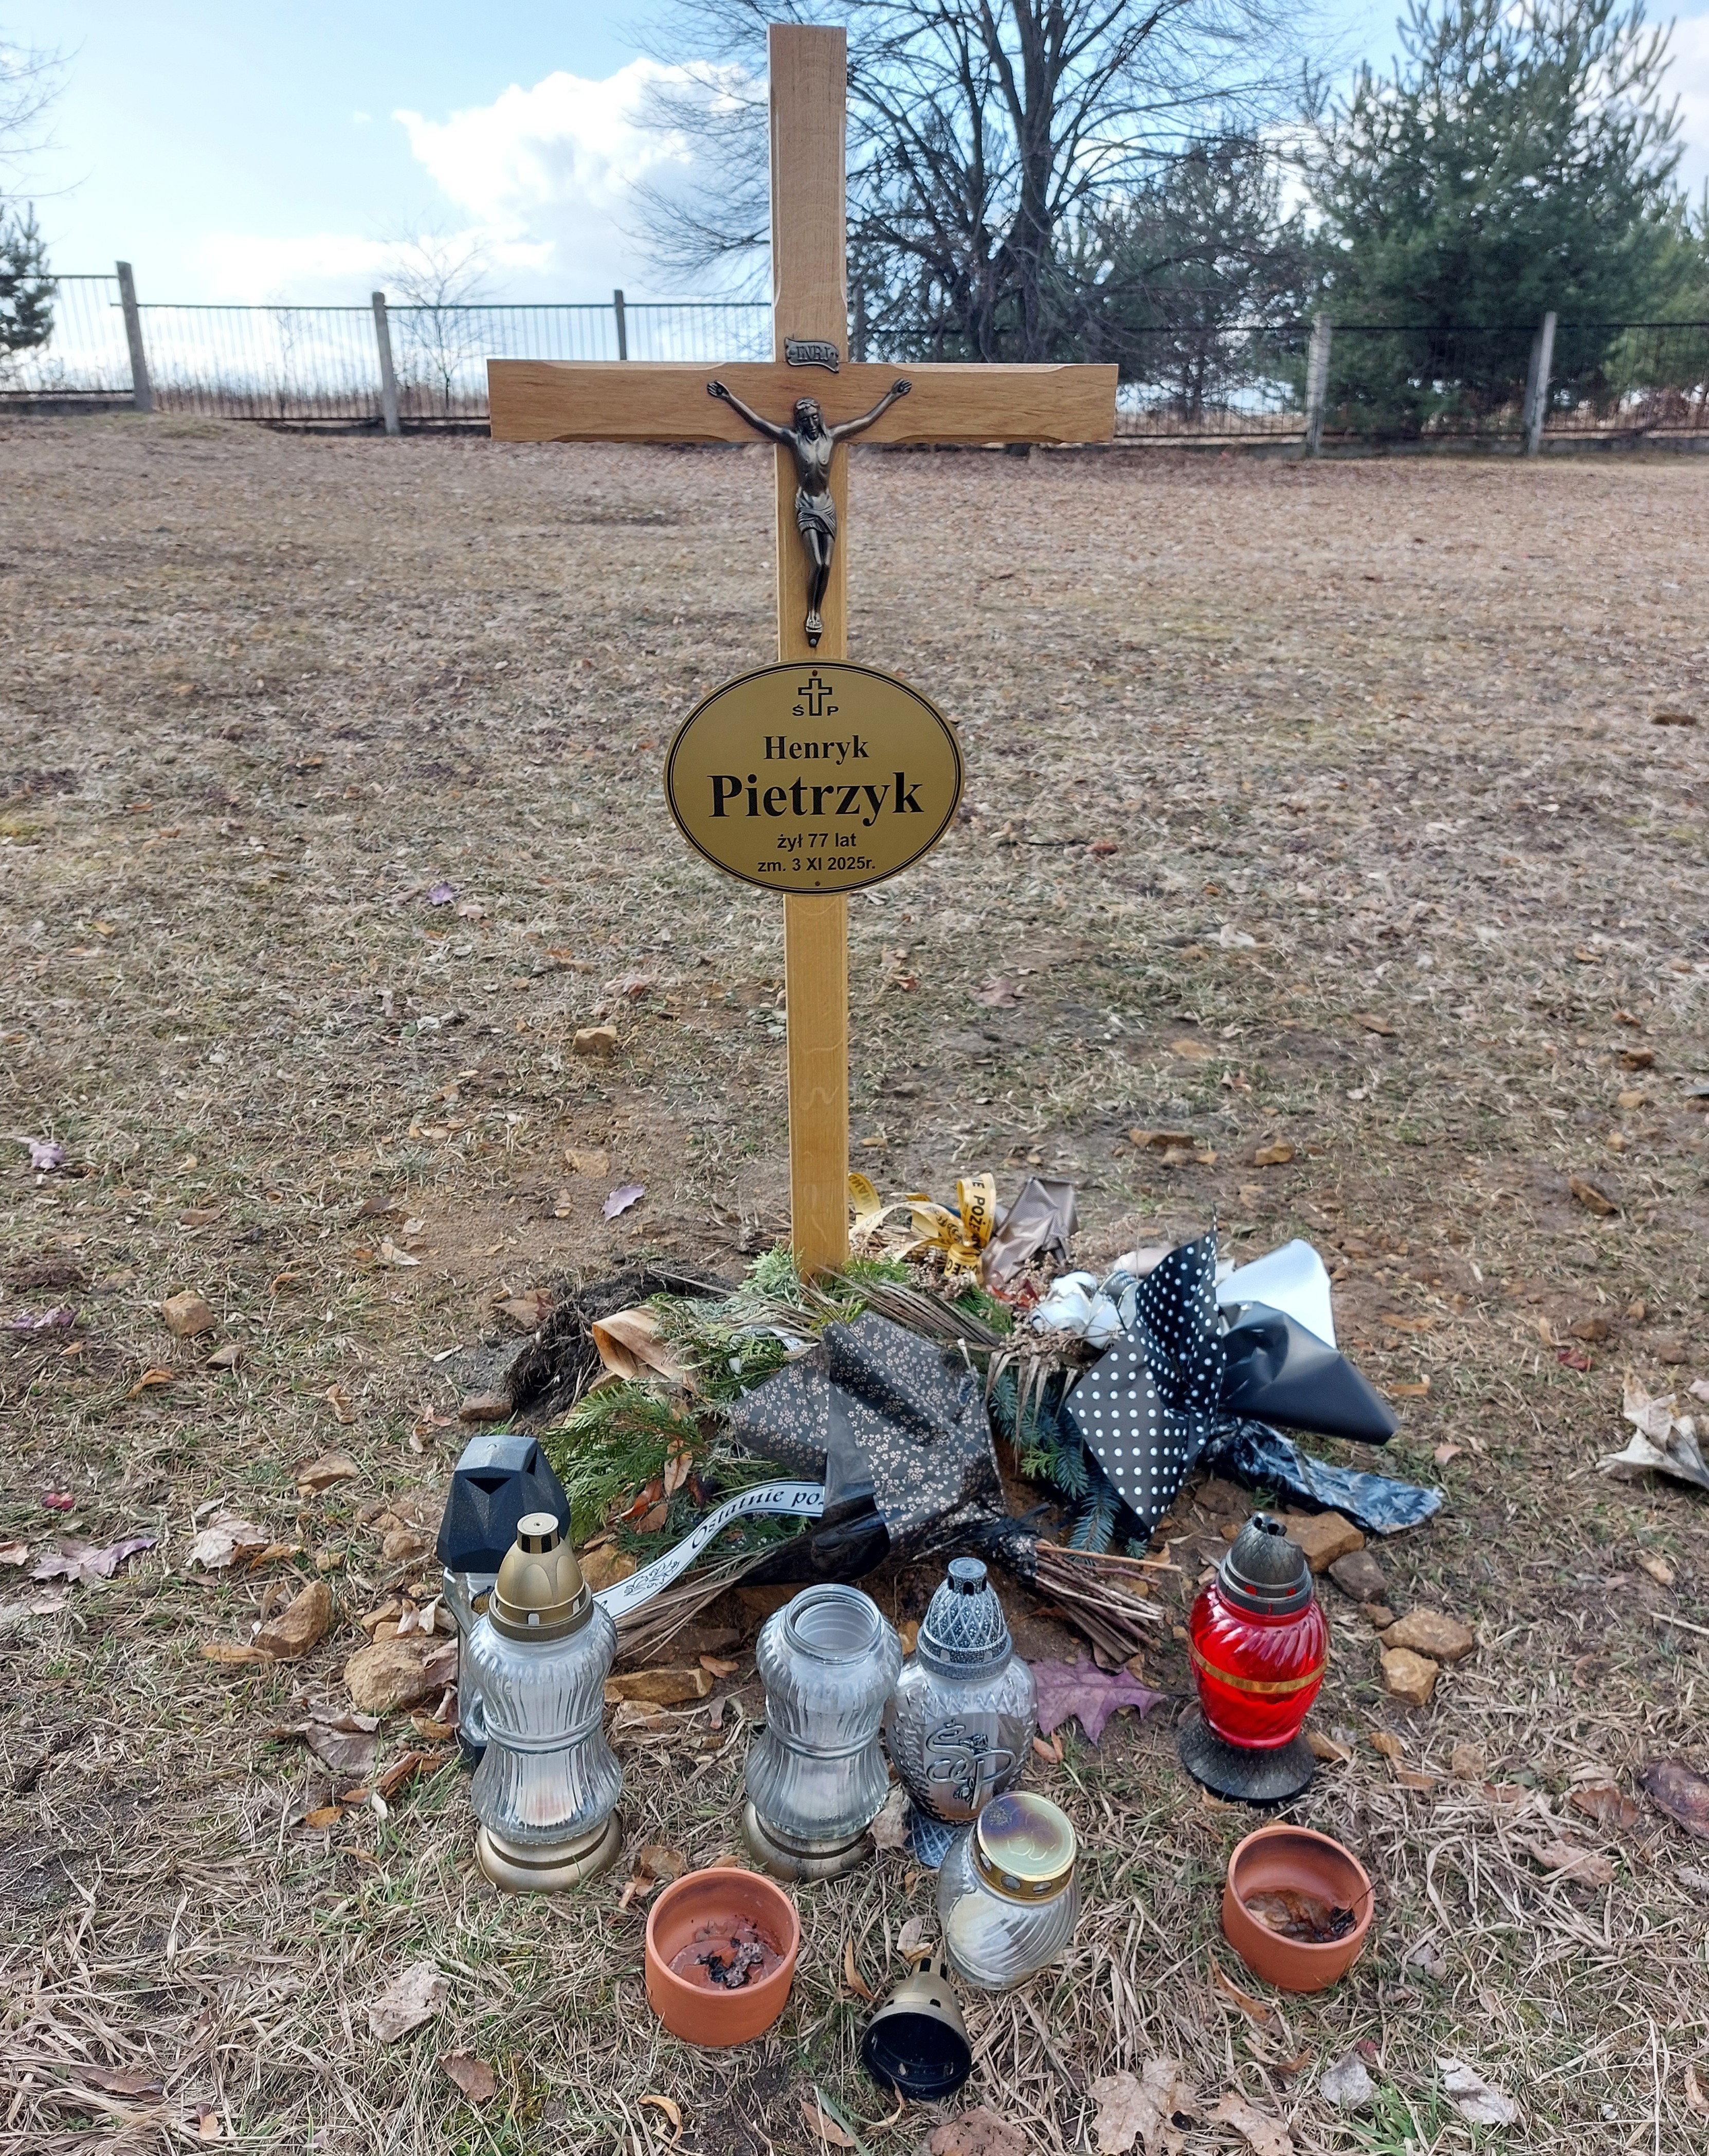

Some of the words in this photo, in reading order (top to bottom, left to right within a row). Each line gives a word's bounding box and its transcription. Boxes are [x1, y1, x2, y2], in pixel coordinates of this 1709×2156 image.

[796, 346, 830, 361] INRI
[763, 735, 869, 765] Henryk
[707, 772, 924, 827] Pietrzyk
[777, 834, 803, 852] żył
[808, 833, 829, 847] 77
[835, 832, 857, 847] lat
[757, 861, 786, 872] zm.
[792, 858, 801, 871] 3
[806, 857, 822, 871] XI
[827, 856, 876, 871] 2025r.
[692, 1489, 785, 1549] Ostatnie
[791, 1491, 824, 1508] po
